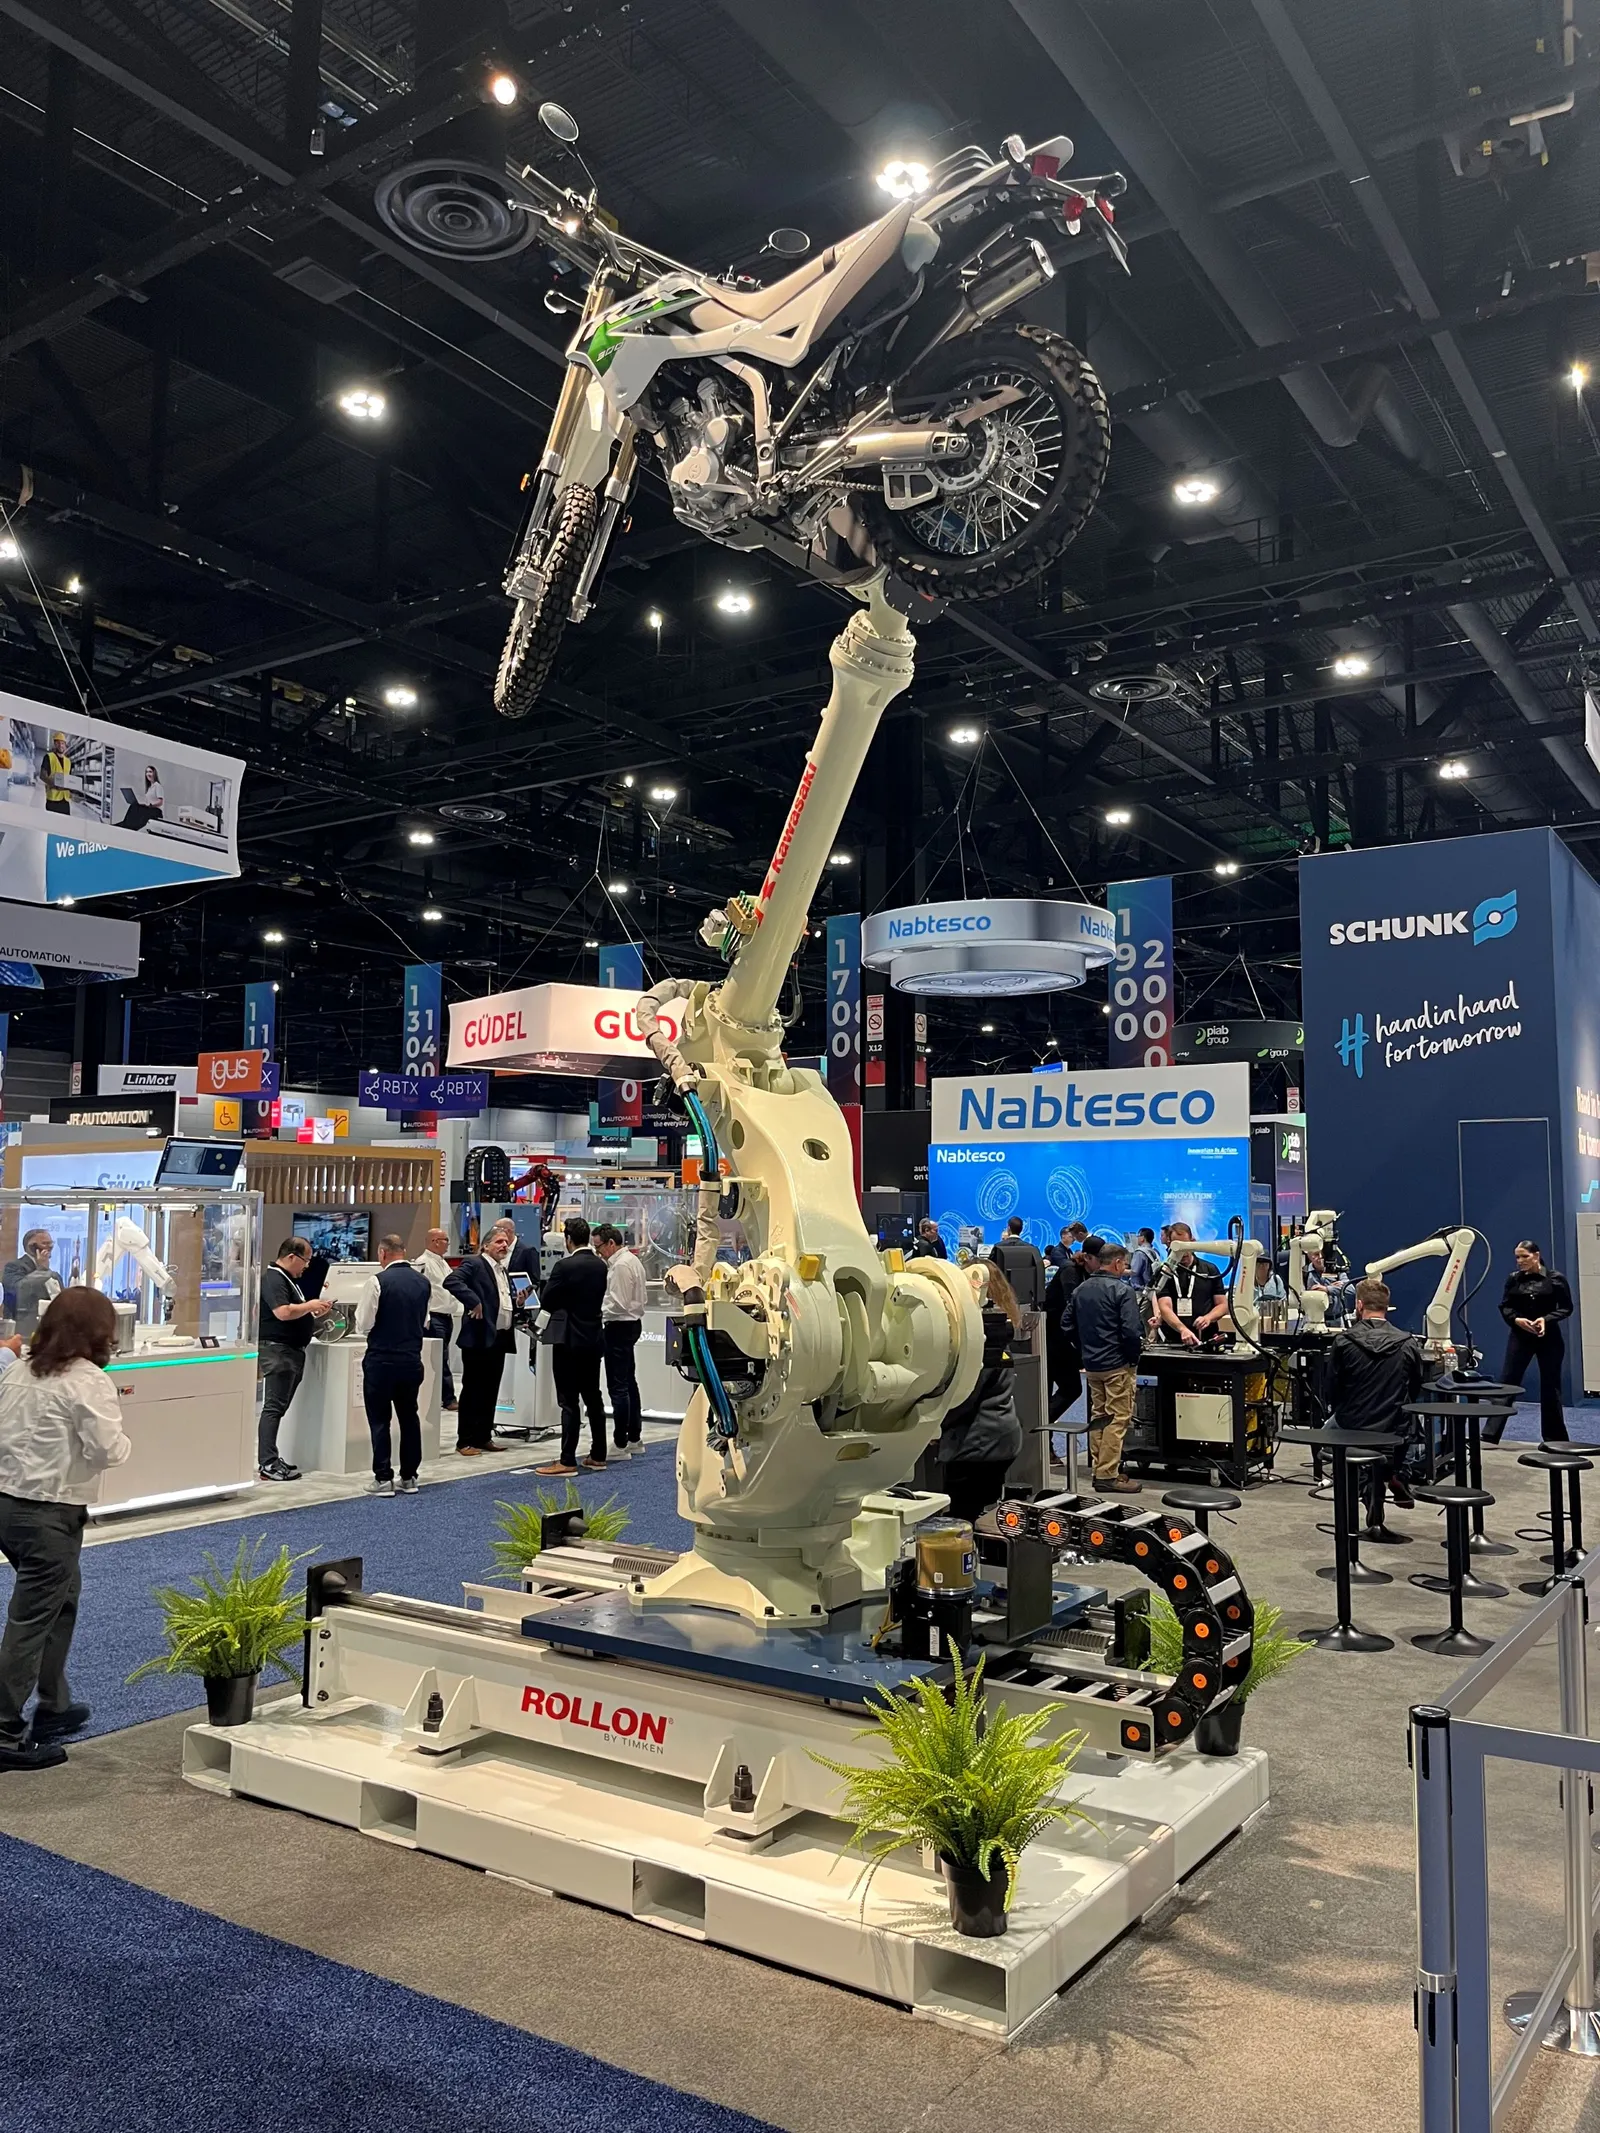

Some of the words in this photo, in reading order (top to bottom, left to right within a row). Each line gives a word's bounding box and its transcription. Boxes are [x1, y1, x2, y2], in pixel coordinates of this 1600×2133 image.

[771, 761, 818, 874] Kawasaki
[56, 841, 75, 858] We
[888, 915, 992, 940] Nabtesco
[1329, 909, 1469, 946] SCHUNK
[0, 946, 71, 963] AUTOMATION
[464, 1010, 527, 1048] GÜDEL
[1207, 1025, 1229, 1037] piab
[868, 1044, 883, 1052] X12
[1206, 1036, 1229, 1046] group
[210, 1056, 250, 1090] igus
[382, 1079, 419, 1095] RBTX
[447, 1080, 482, 1095] RBTX
[959, 1083, 1216, 1132] Nabtesco
[81, 1110, 149, 1125] AUTOMATION
[664, 1120, 689, 1128] everyday
[936, 1149, 1006, 1163] Nabtesco
[1163, 1192, 1213, 1200] INNOVATION
[604, 1732, 618, 1744] BY
[622, 1736, 664, 1755] TIMKEN
